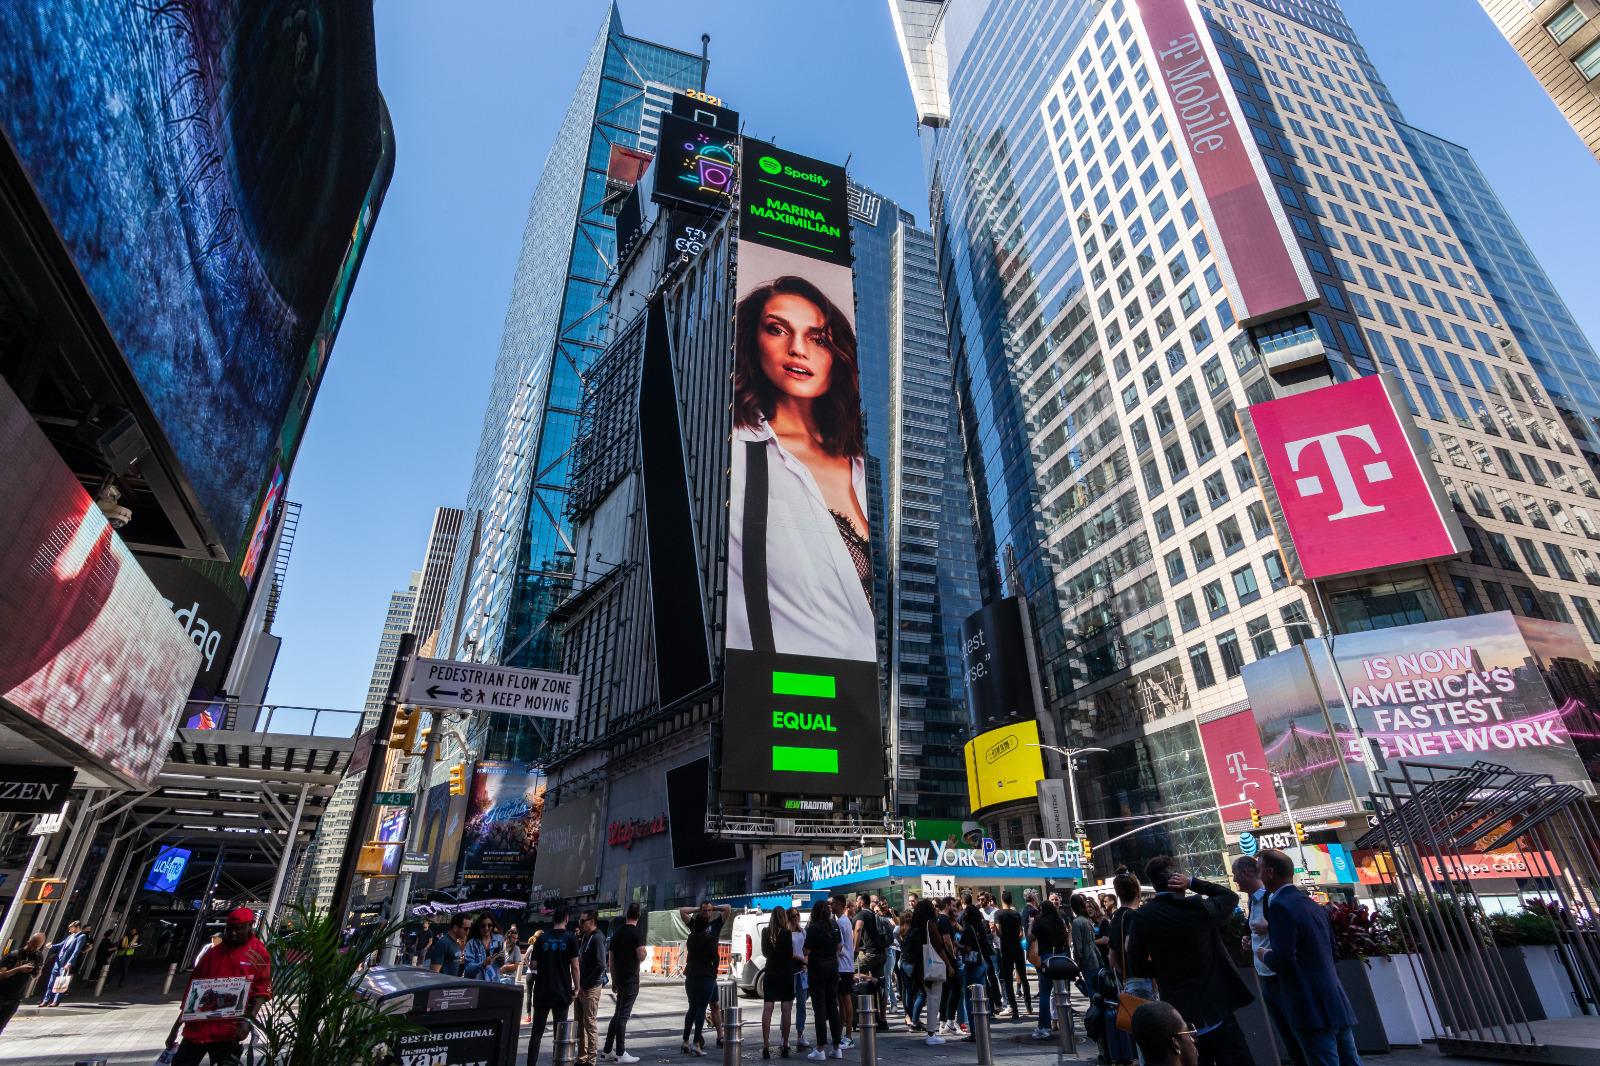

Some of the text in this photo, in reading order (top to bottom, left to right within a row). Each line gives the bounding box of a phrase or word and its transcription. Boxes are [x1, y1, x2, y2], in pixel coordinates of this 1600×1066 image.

[686, 88, 722, 107] 2021
[783, 165, 829, 188] Spotify
[750, 204, 841, 238] MAXIMILIAN
[766, 197, 826, 223] MARINA
[1362, 645, 1474, 681] IS NOW
[428, 665, 573, 695] PEDESTRIAN FLOW ZONE
[491, 691, 570, 713] KEEP MOVING
[772, 710, 838, 732] EQUAL
[1373, 697, 1506, 732] FASTEST
[1394, 719, 1566, 758] NETWORK
[375, 793, 385, 802] W
[387, 793, 401, 804] 43
[886, 838, 932, 867] NEW
[930, 839, 979, 867] YORK
[981, 837, 1037, 868] POLICE
[1259, 833, 1292, 850] AT&T
[422, 1032, 444, 1042] THE
[444, 1028, 495, 1041] ORIGINAL
